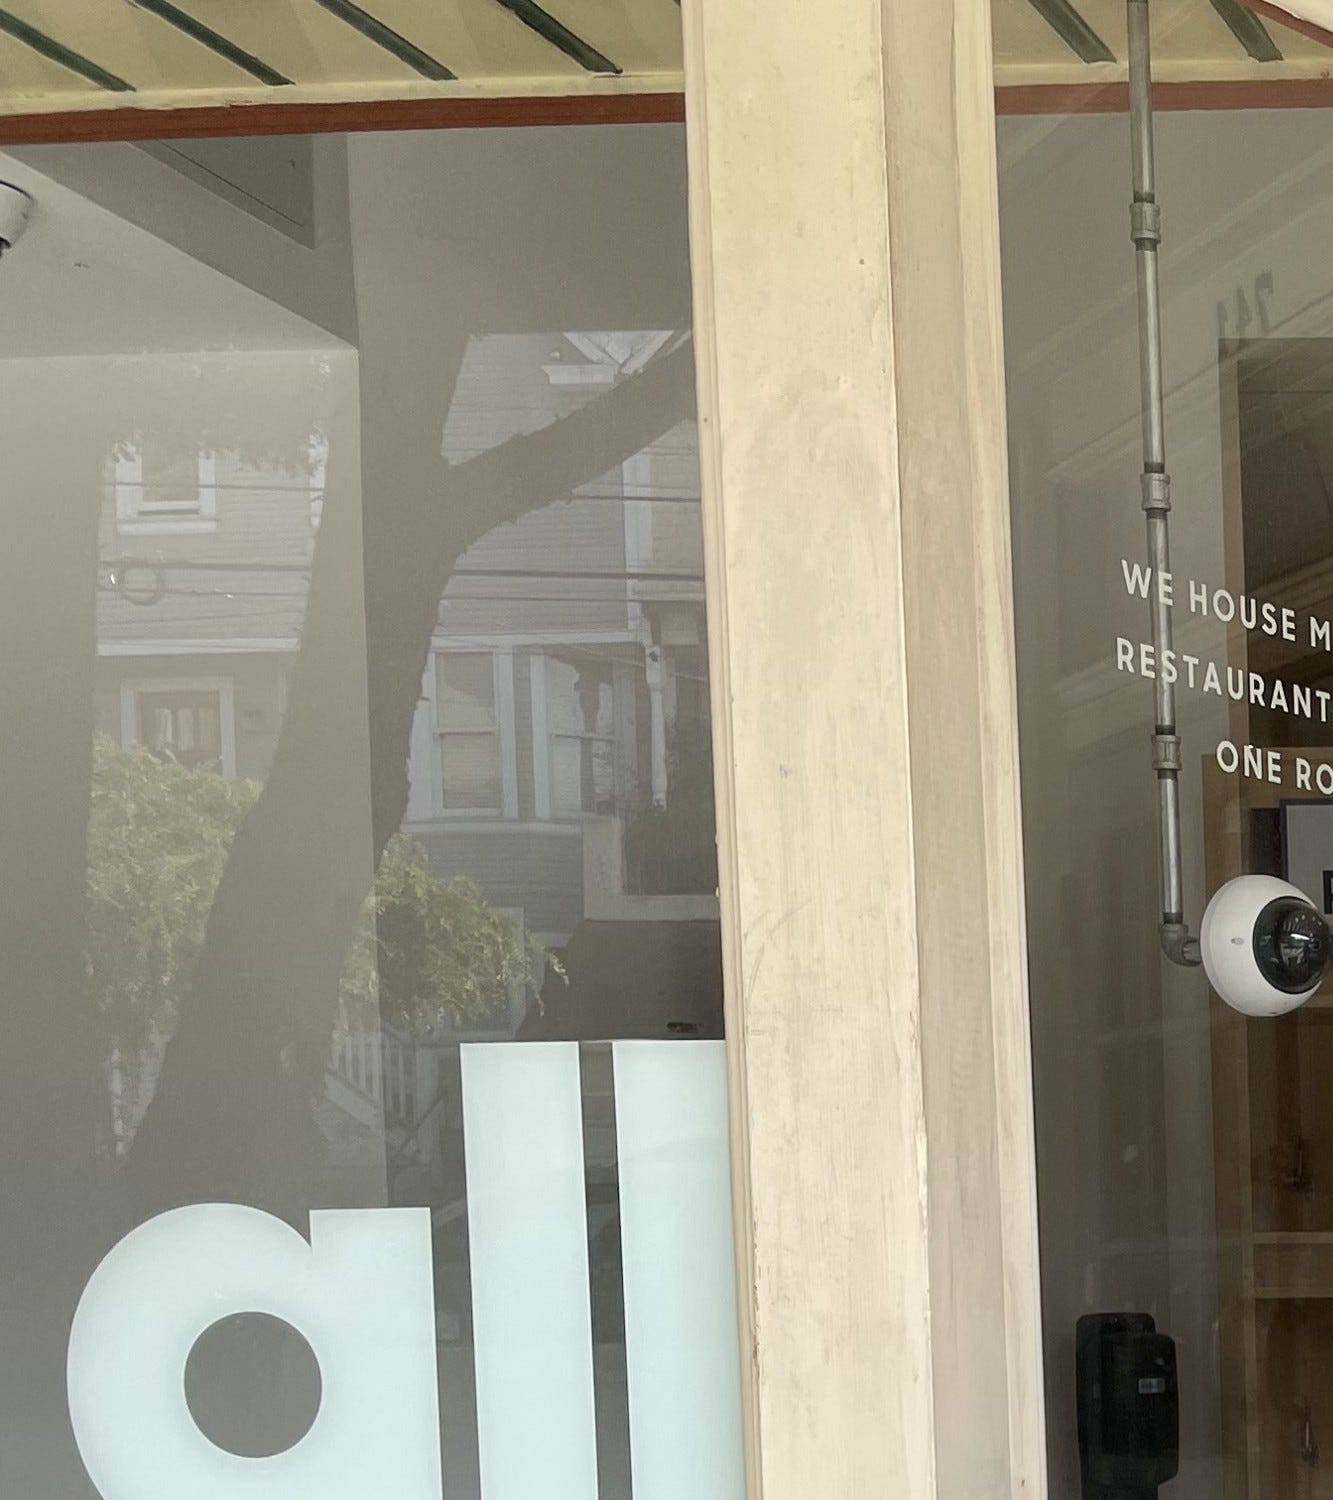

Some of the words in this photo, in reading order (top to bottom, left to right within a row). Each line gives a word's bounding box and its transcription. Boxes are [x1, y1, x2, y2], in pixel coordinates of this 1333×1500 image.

[1121, 558, 1174, 606] WE
[1189, 581, 1297, 642] HOUSE
[1216, 741, 1283, 785] ONE
